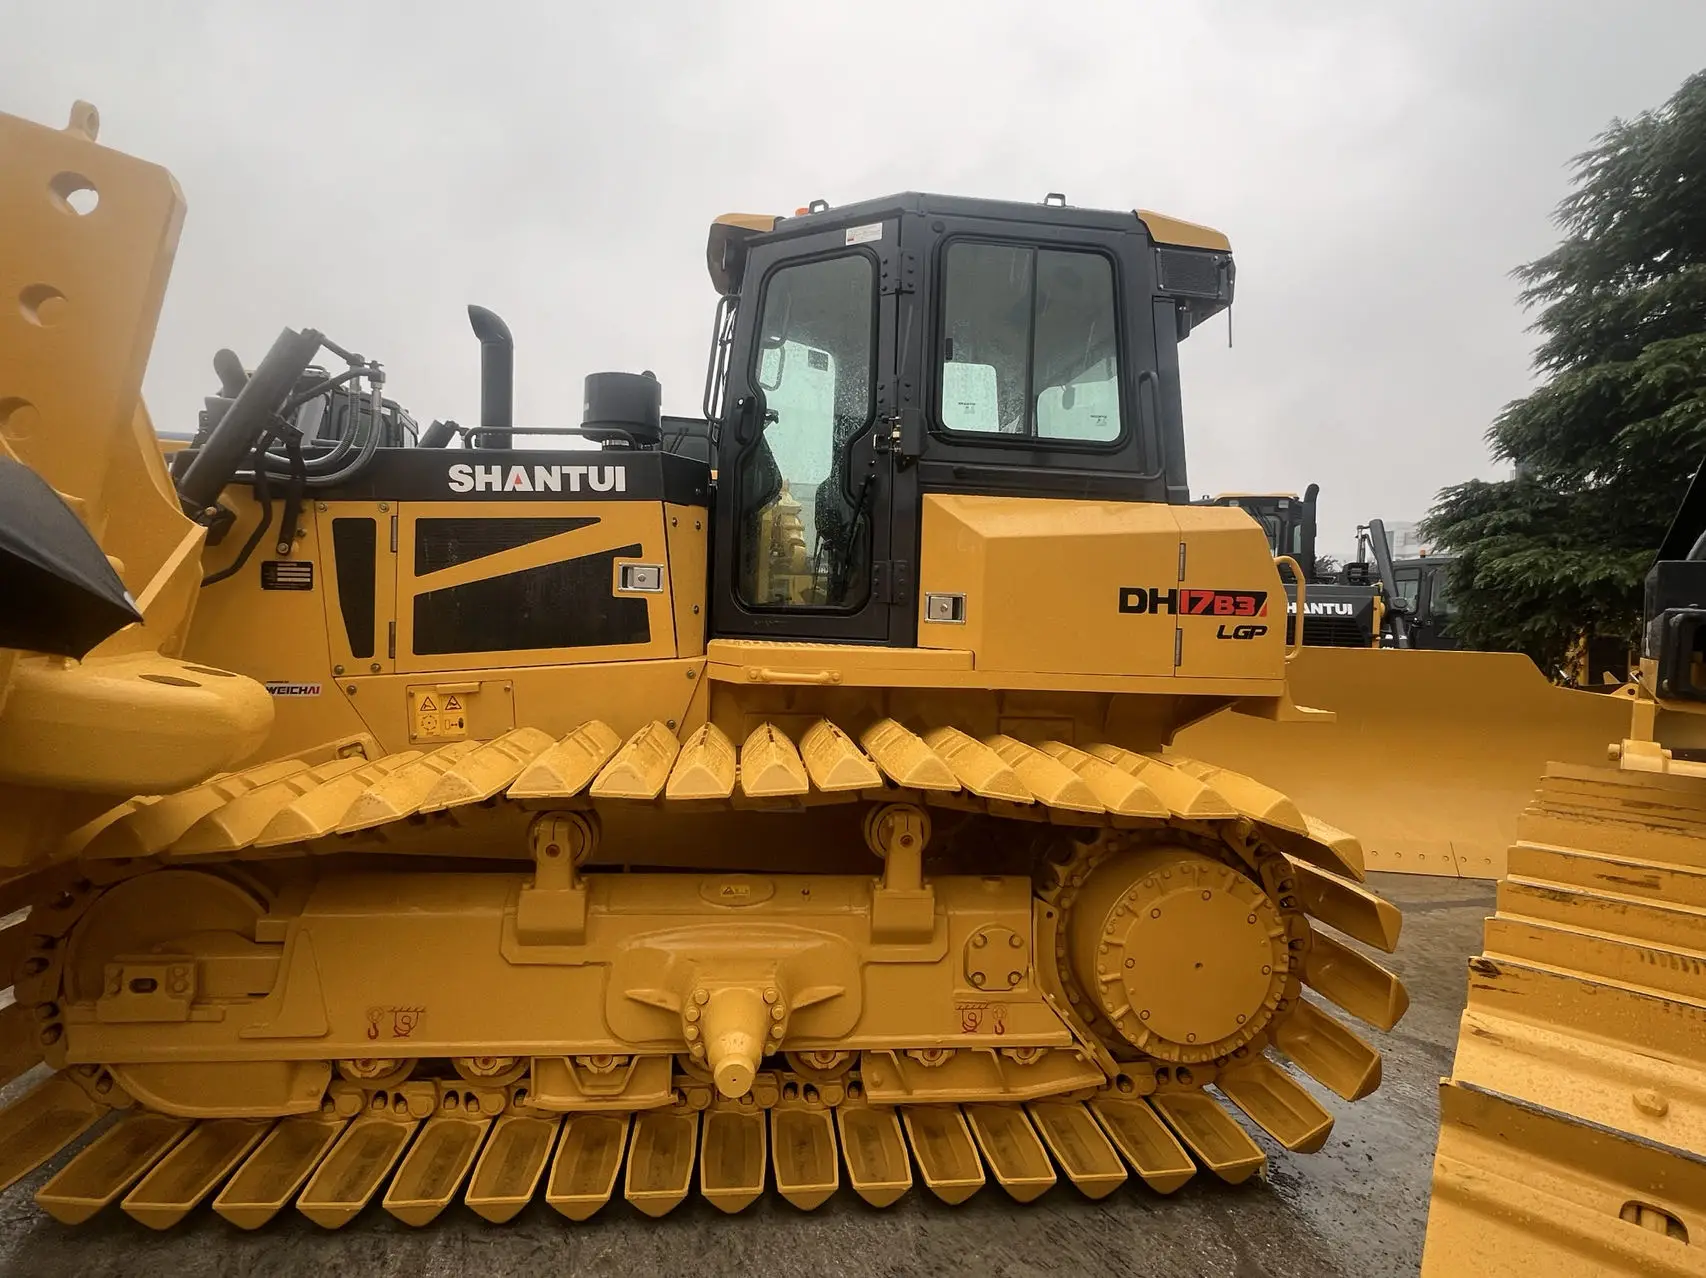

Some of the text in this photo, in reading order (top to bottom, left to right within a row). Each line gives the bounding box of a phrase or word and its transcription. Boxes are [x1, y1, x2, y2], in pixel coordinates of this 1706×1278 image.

[448, 464, 626, 493] SHANTUI
[1286, 602, 1354, 615] HANTUI
[1216, 625, 1268, 639] LGP
[265, 686, 321, 695] WEICHAI
